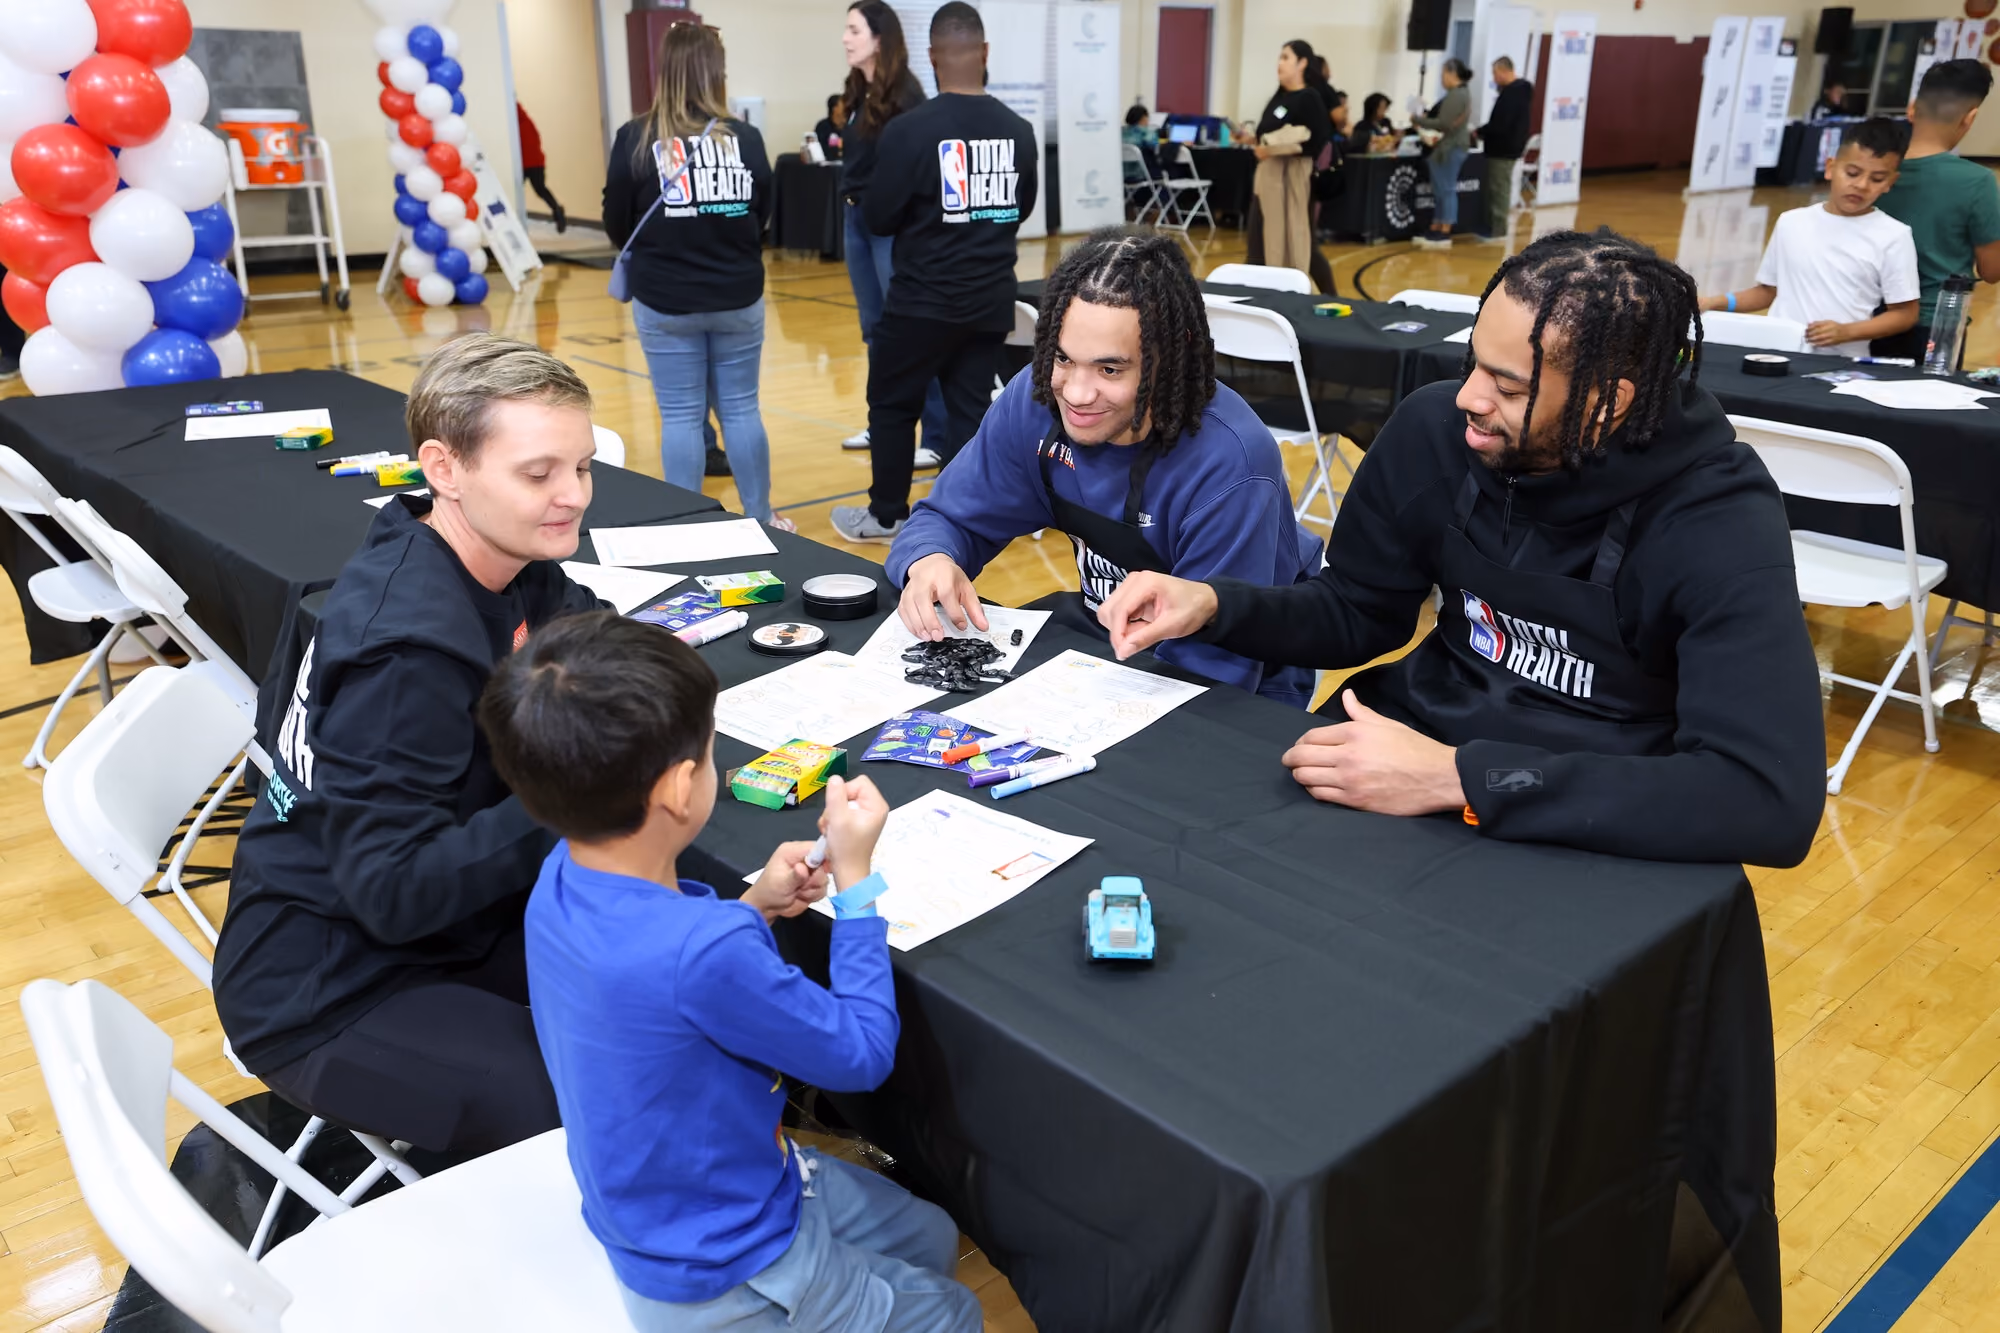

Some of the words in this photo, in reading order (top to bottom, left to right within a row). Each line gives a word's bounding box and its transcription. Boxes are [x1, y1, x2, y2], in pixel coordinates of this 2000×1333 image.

[267, 132, 289, 156] G
[688, 136, 745, 169] TOTAL
[969, 139, 1015, 174] TOTAL
[693, 167, 754, 202] HEALTH
[1474, 632, 1492, 653] NBA
[1497, 610, 1580, 658] TOTAL
[1506, 635, 1595, 698] HEALTH
